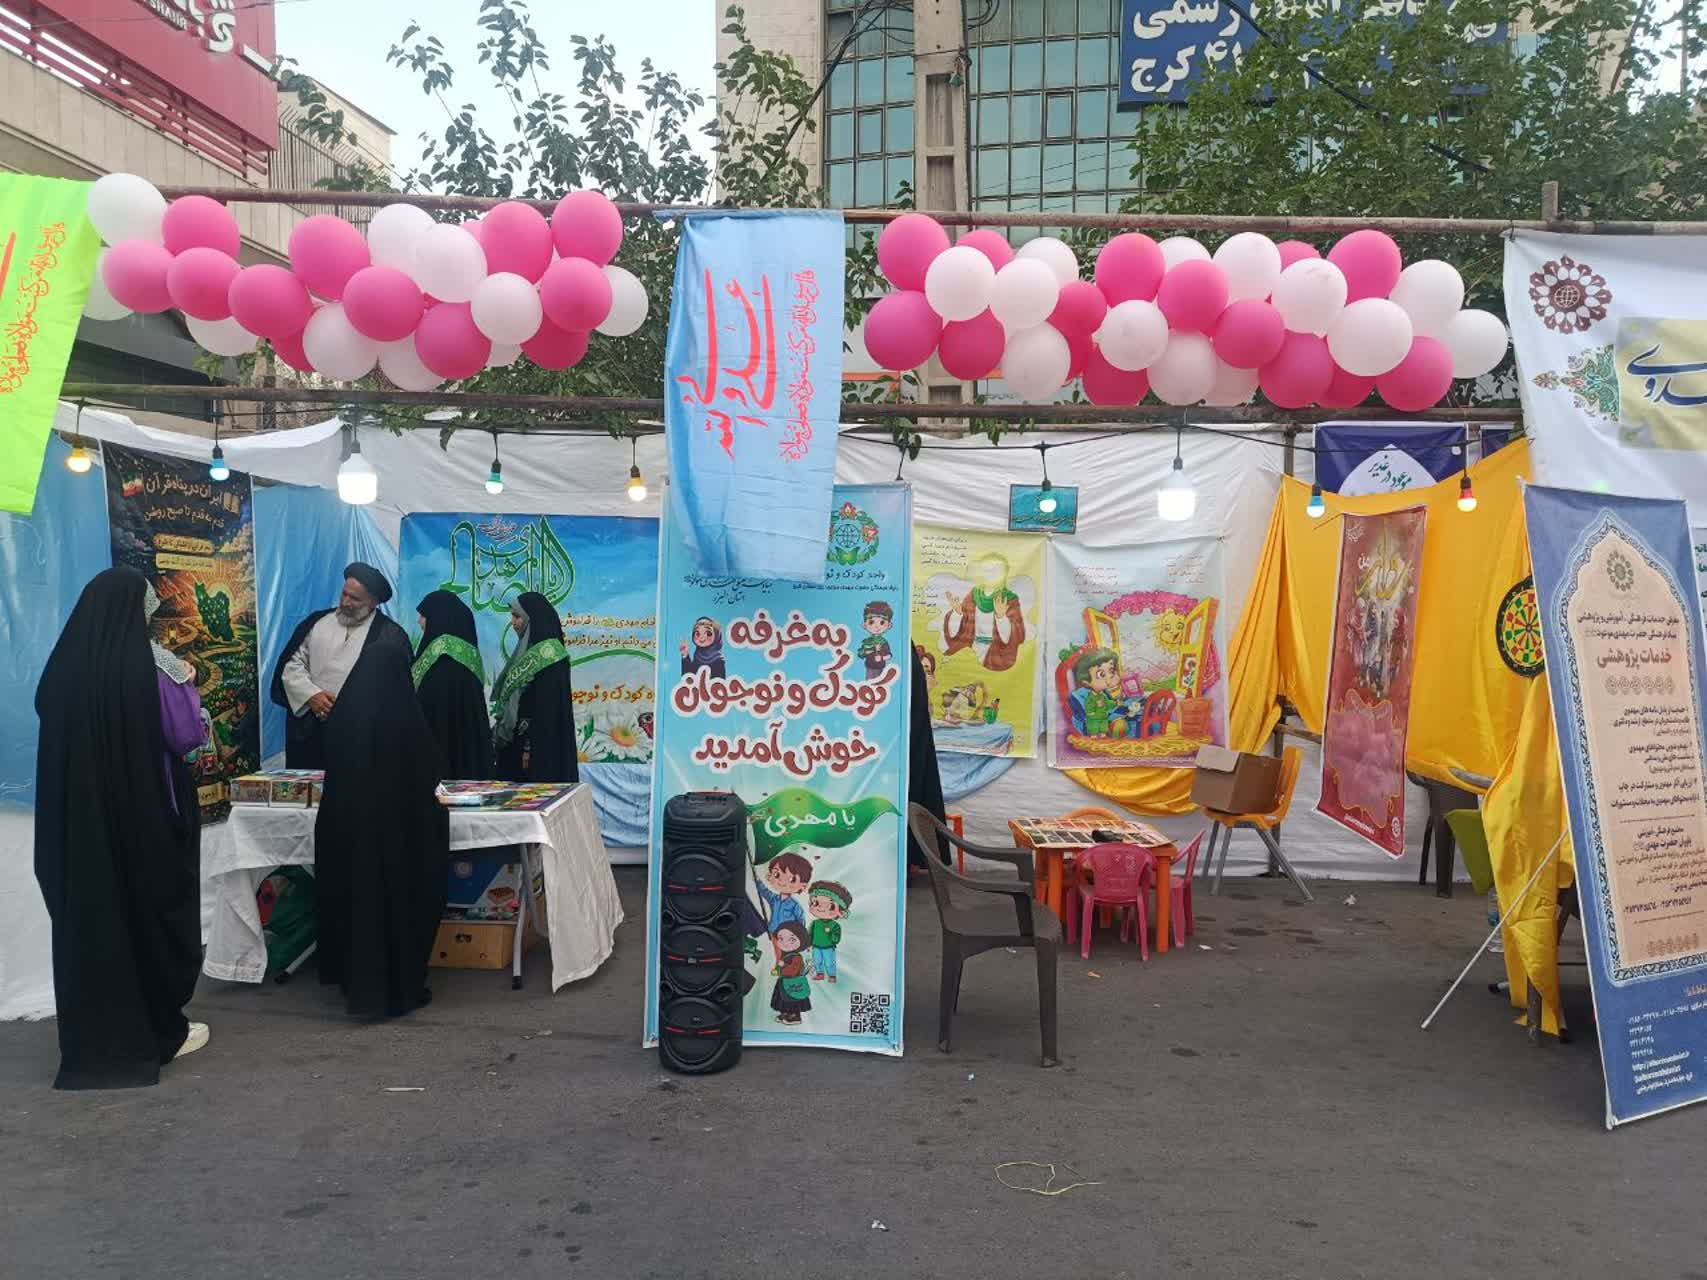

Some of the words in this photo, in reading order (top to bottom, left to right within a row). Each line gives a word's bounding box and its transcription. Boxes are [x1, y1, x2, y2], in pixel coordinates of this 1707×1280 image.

[1130, 45, 1197, 92] کرج
[1368, 455, 1389, 477] غدیر
[145, 471, 172, 496] قرآن
[199, 482, 224, 506] ایران
[166, 506, 183, 521] صبح
[843, 568, 866, 581] کودک
[729, 611, 811, 659] غرفه
[811, 625, 849, 656] به
[1596, 647, 1640, 670] پژوهشی
[1639, 647, 1672, 664] خدمات
[570, 684, 600, 705] نوجو
[611, 683, 645, 704] کودک
[673, 669, 784, 714] نوجوان
[808, 653, 898, 716] کودک
[601, 691, 610, 704] و
[785, 681, 806, 716] و
[695, 721, 783, 769] آمدید
[782, 728, 877, 776] خوش
[763, 808, 838, 838] مهدی
[841, 808, 856, 830] یا
